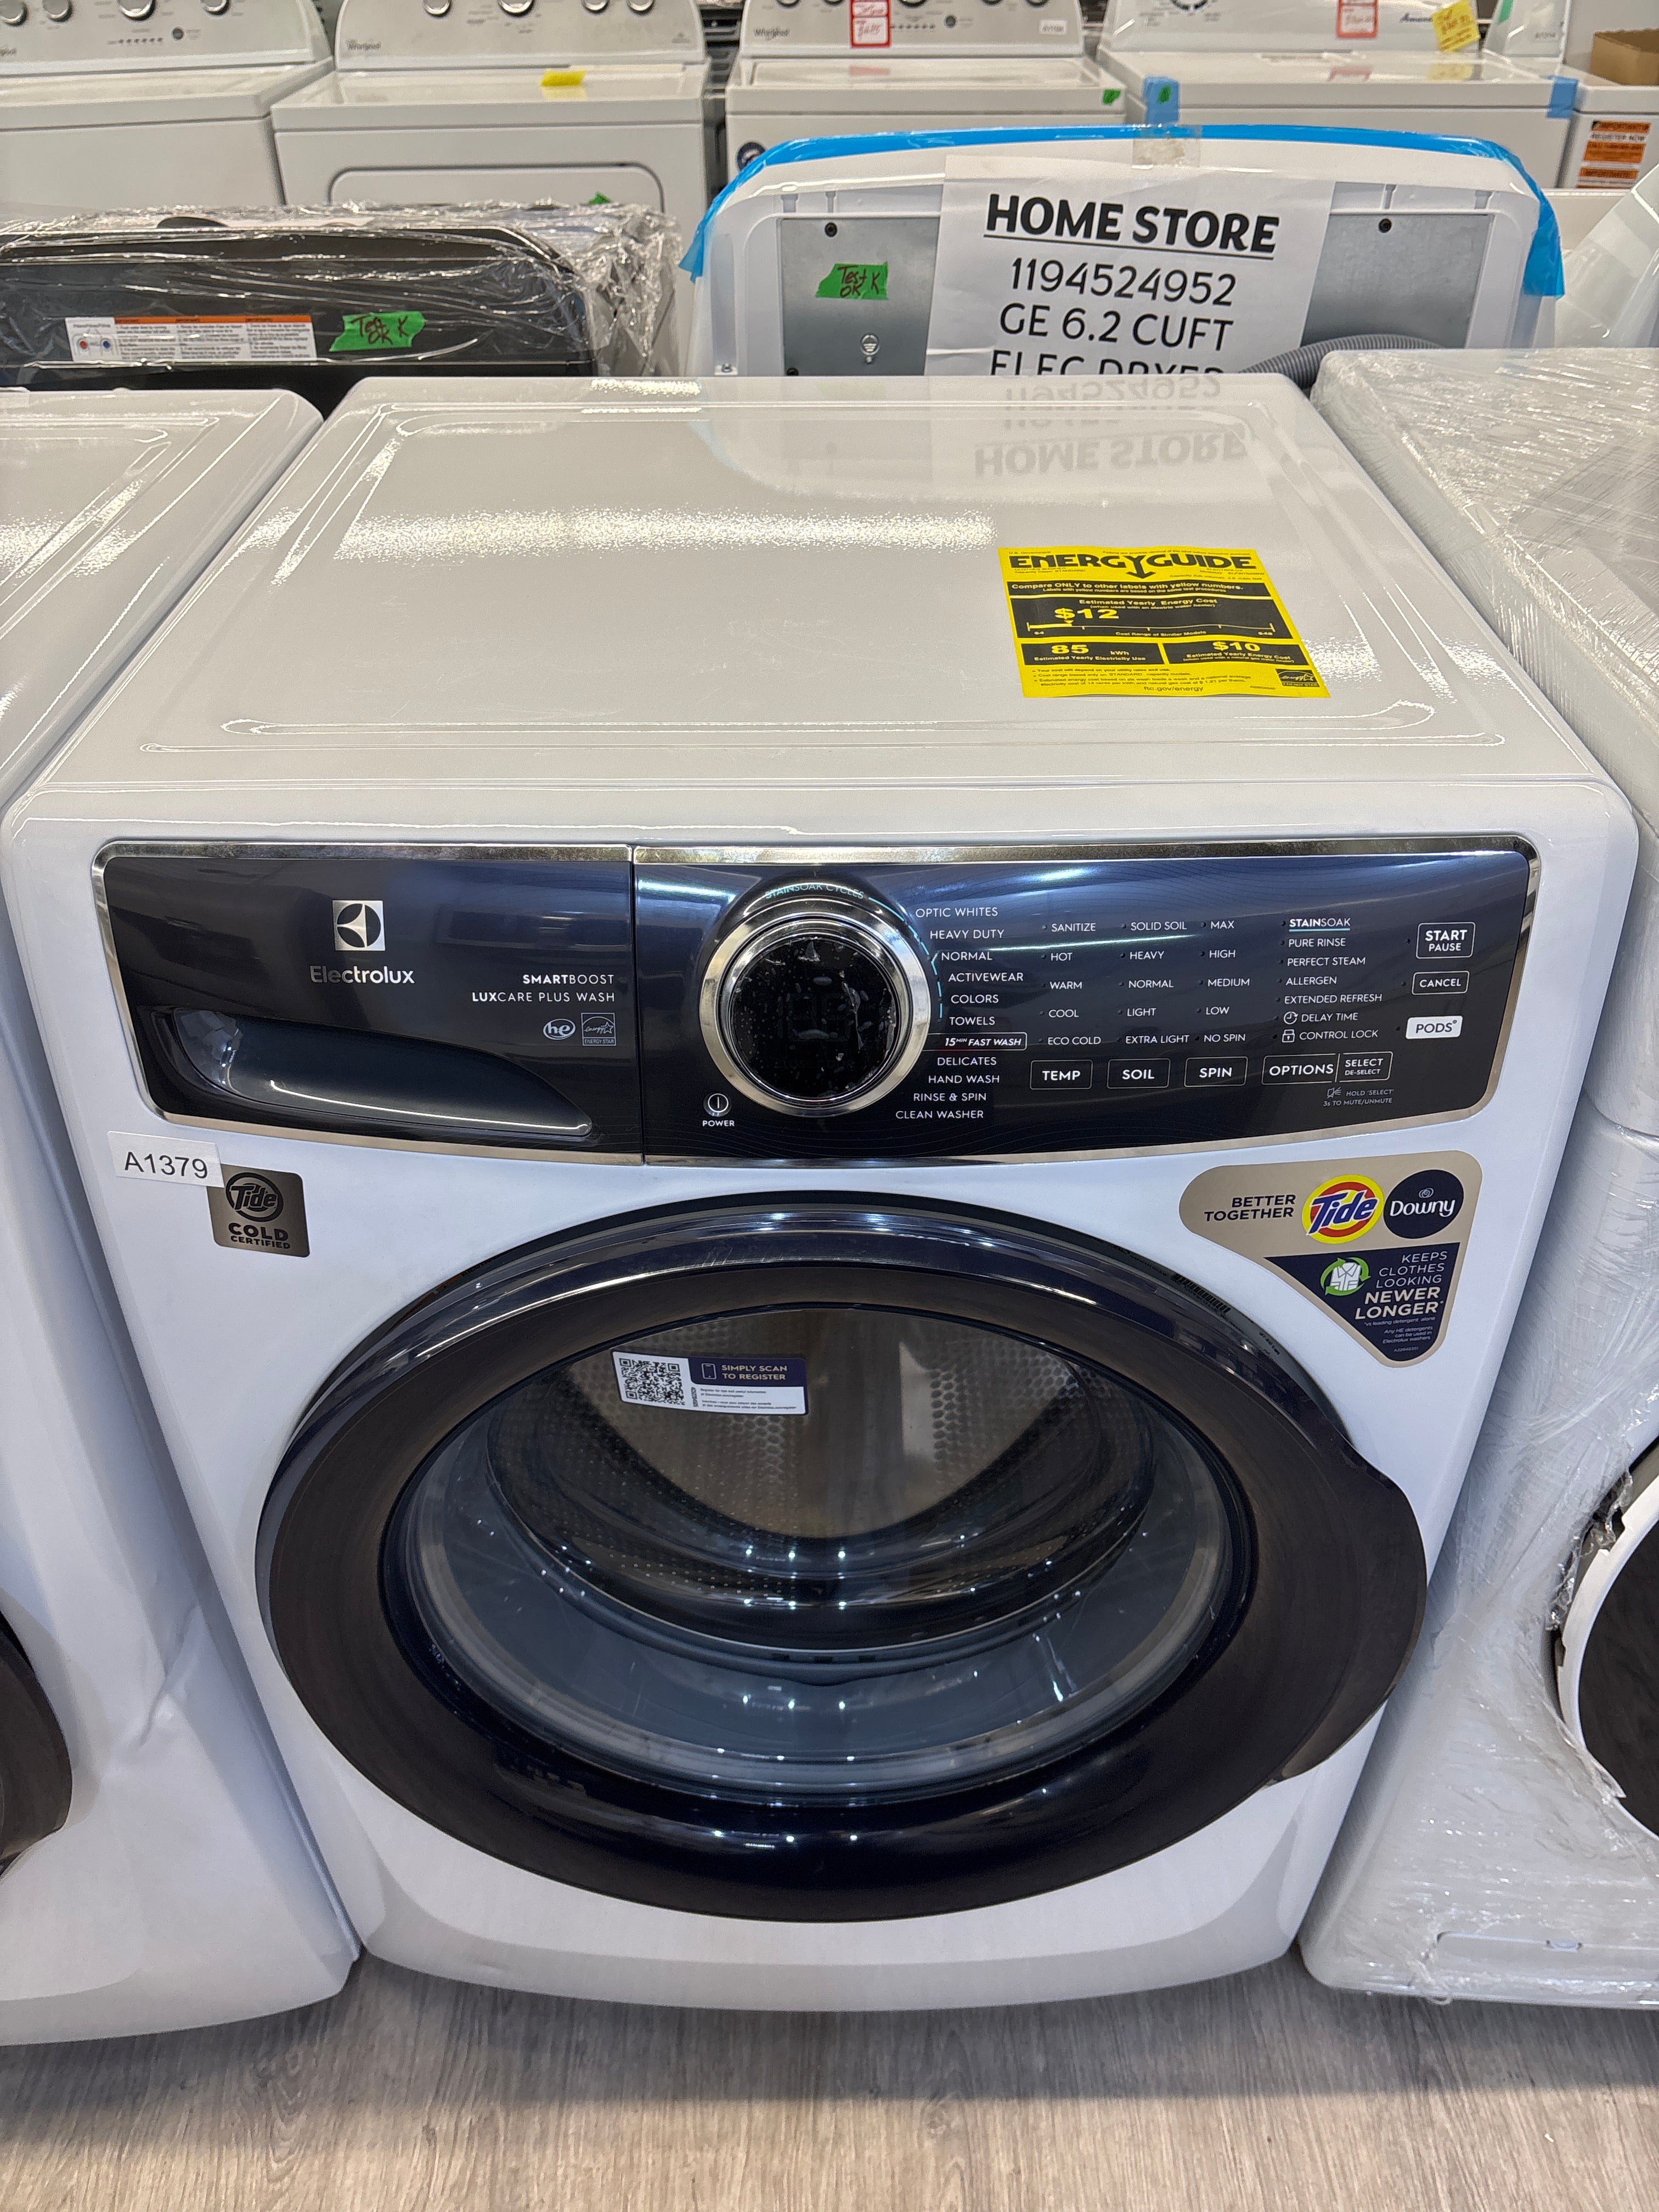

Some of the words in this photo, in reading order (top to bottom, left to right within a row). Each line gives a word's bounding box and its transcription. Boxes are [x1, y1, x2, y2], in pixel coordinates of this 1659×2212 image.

[986, 194, 1123, 240] HOME
[1132, 206, 1279, 253] STORE
[837, 265, 867, 284] Test
[871, 272, 881, 295] K
[1012, 257, 1237, 306] 1194524952
[840, 283, 864, 298] OK
[1000, 302, 1049, 337] GE
[1062, 307, 1121, 342] 6.2
[1132, 313, 1234, 351] CUFT
[1009, 553, 1257, 578] ENERGYGUIDE
[1054, 608, 1119, 619] $12
[1051, 644, 1089, 654] 85
[1212, 641, 1260, 652] $10
[915, 907, 951, 918] OPTIC
[955, 907, 998, 917] WHITES
[1051, 923, 1096, 932] SANITIZE
[1131, 922, 1161, 931] SOLID
[1164, 921, 1187, 930] SOIL
[1210, 921, 1235, 929] MAX
[1289, 917, 1351, 928] STAINSOAK
[930, 930, 969, 939] HEAVY
[973, 929, 1005, 939] DUTY
[1425, 929, 1468, 941] START
[1288, 939, 1315, 947] PURE
[1317, 938, 1346, 947] RINSE
[1429, 943, 1462, 952] PAUSE
[941, 951, 993, 961] NORMAL
[1051, 952, 1073, 961] HOT
[1130, 951, 1164, 960] HEAVY
[1209, 950, 1235, 958] HIGH
[1287, 958, 1330, 967] PERFECT
[1332, 957, 1366, 966] STEAM
[309, 966, 415, 984] Electrolux
[522, 974, 614, 984] SMARTBOOST
[948, 972, 1024, 982] ACTIVEWEAR
[1049, 981, 1082, 990] WARM
[1128, 980, 1174, 989] NORMAL
[1207, 978, 1250, 987] MEDIUM
[1286, 977, 1337, 985] ALLERGEN
[1419, 979, 1462, 988] CANCEL
[472, 992, 533, 1002] LUXCARE
[539, 992, 571, 1002] PLUS
[576, 992, 615, 1002] WASH
[951, 994, 999, 1004] COLORS
[1284, 995, 1338, 1004] EXTENDED
[1340, 994, 1383, 1003] REFRESH
[1048, 1009, 1079, 1018] COOL
[1127, 1008, 1156, 1017] LIGHT
[1206, 1006, 1230, 1015] LOW
[949, 1016, 995, 1026] TOWELS
[1301, 1014, 1333, 1022] DELAY
[1335, 1013, 1359, 1021] TIME
[1126, 1036, 1158, 1044] EXTRA
[1160, 1035, 1190, 1043] LIGHT
[1204, 1034, 1222, 1043] NO
[1223, 1034, 1246, 1042] SPIN
[1299, 1031, 1348, 1040] CONTROL
[1351, 1030, 1379, 1039] LOCK
[1048, 1037, 1070, 1046] ECO
[1072, 1036, 1102, 1045] COLD
[937, 1057, 997, 1066] DELICATES
[1345, 1058, 1384, 1068] SELECT
[1122, 1069, 1155, 1080] SOIL
[1199, 1067, 1233, 1078] SPIN
[1269, 1063, 1334, 1076] OPTIONS
[928, 1075, 962, 1084] HAND
[966, 1075, 1000, 1084] WASH
[1042, 1070, 1081, 1081] TEMP
[913, 1093, 946, 1102] RINSE
[949, 1093, 958, 1102] &
[961, 1093, 986, 1102] SPIN
[895, 1110, 933, 1119] CLEAN
[936, 1110, 984, 1119] WASHER
[702, 1119, 735, 1127] POWER
[124, 1151, 208, 1180] A1379
[229, 1184, 278, 1211] Tide
[1231, 1194, 1296, 1208] BETTER
[1306, 1189, 1380, 1235] Tide
[1389, 1198, 1455, 1218] Downy
[1204, 1207, 1294, 1222] TOGETHER
[228, 1222, 289, 1242] COLD
[230, 1235, 291, 1250] CERTIFIED
[1402, 1251, 1448, 1263] KEEPS
[1379, 1263, 1445, 1277] CLOTHES
[1376, 1274, 1442, 1289] LOOKING
[1364, 1286, 1441, 1305] NEWER
[721, 1364, 757, 1372] SIMPLY
